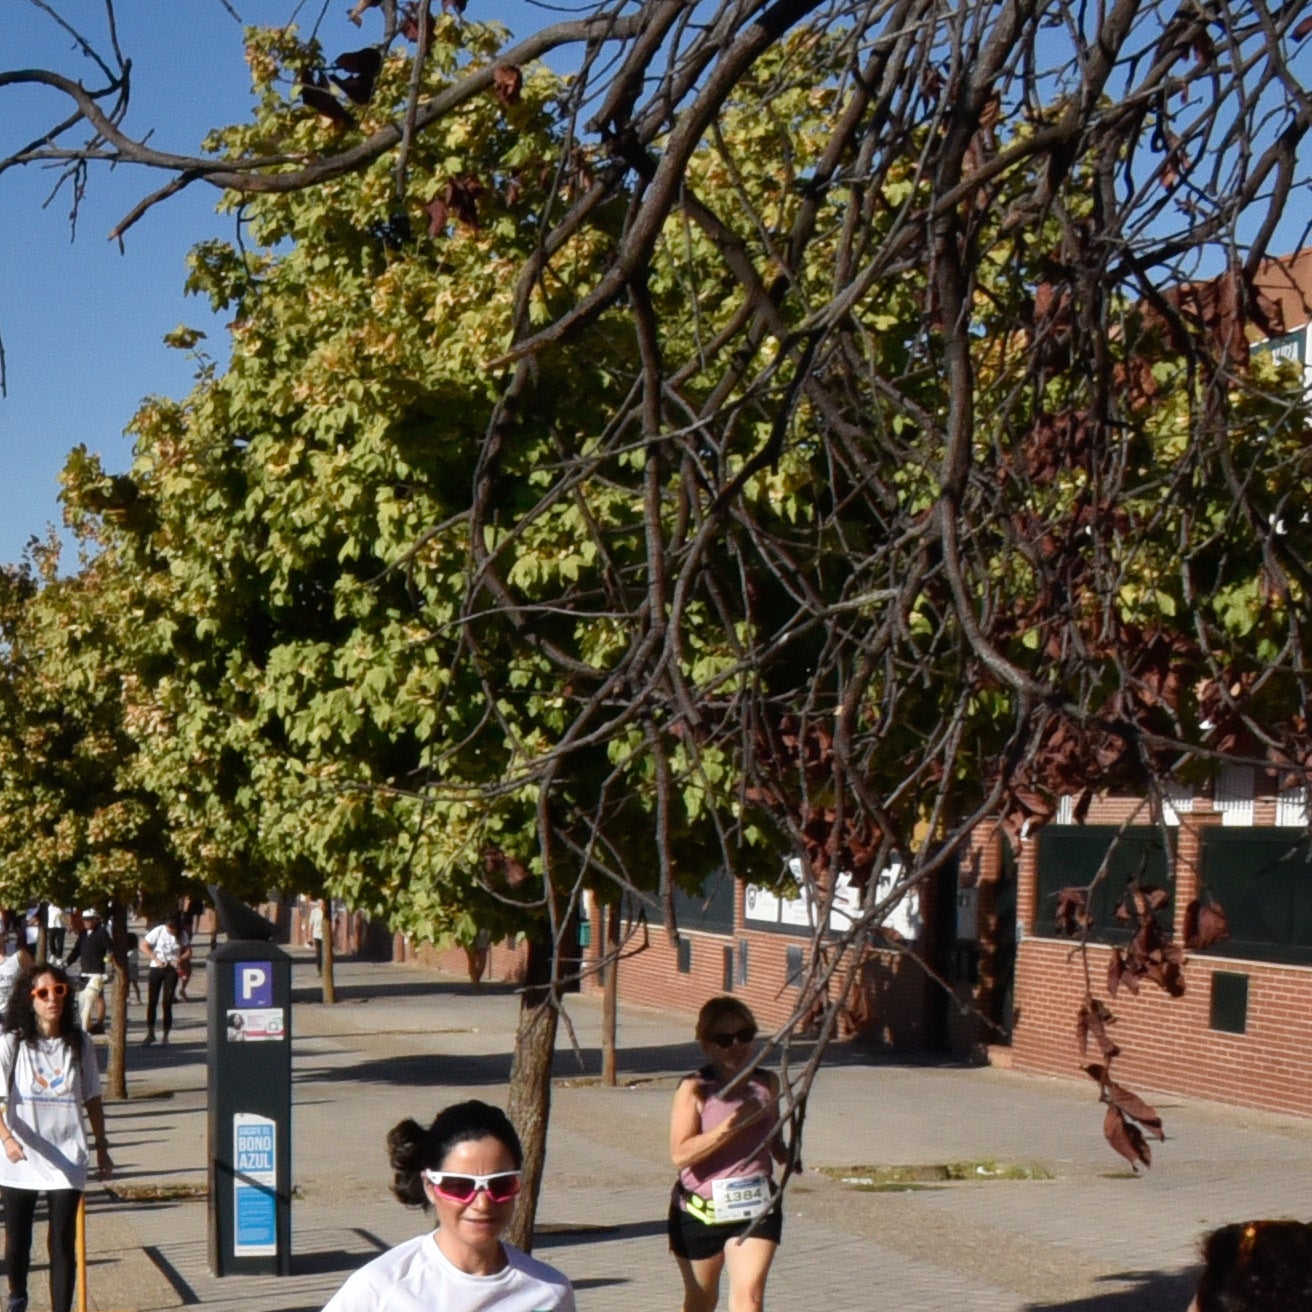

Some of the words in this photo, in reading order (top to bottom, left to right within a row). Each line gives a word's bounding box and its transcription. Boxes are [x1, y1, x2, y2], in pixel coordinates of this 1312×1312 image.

[242, 968, 266, 1000] P
[239, 1137, 271, 1151] BONO
[239, 1153, 271, 1169] AZUL
[724, 1188, 762, 1203] 1384
